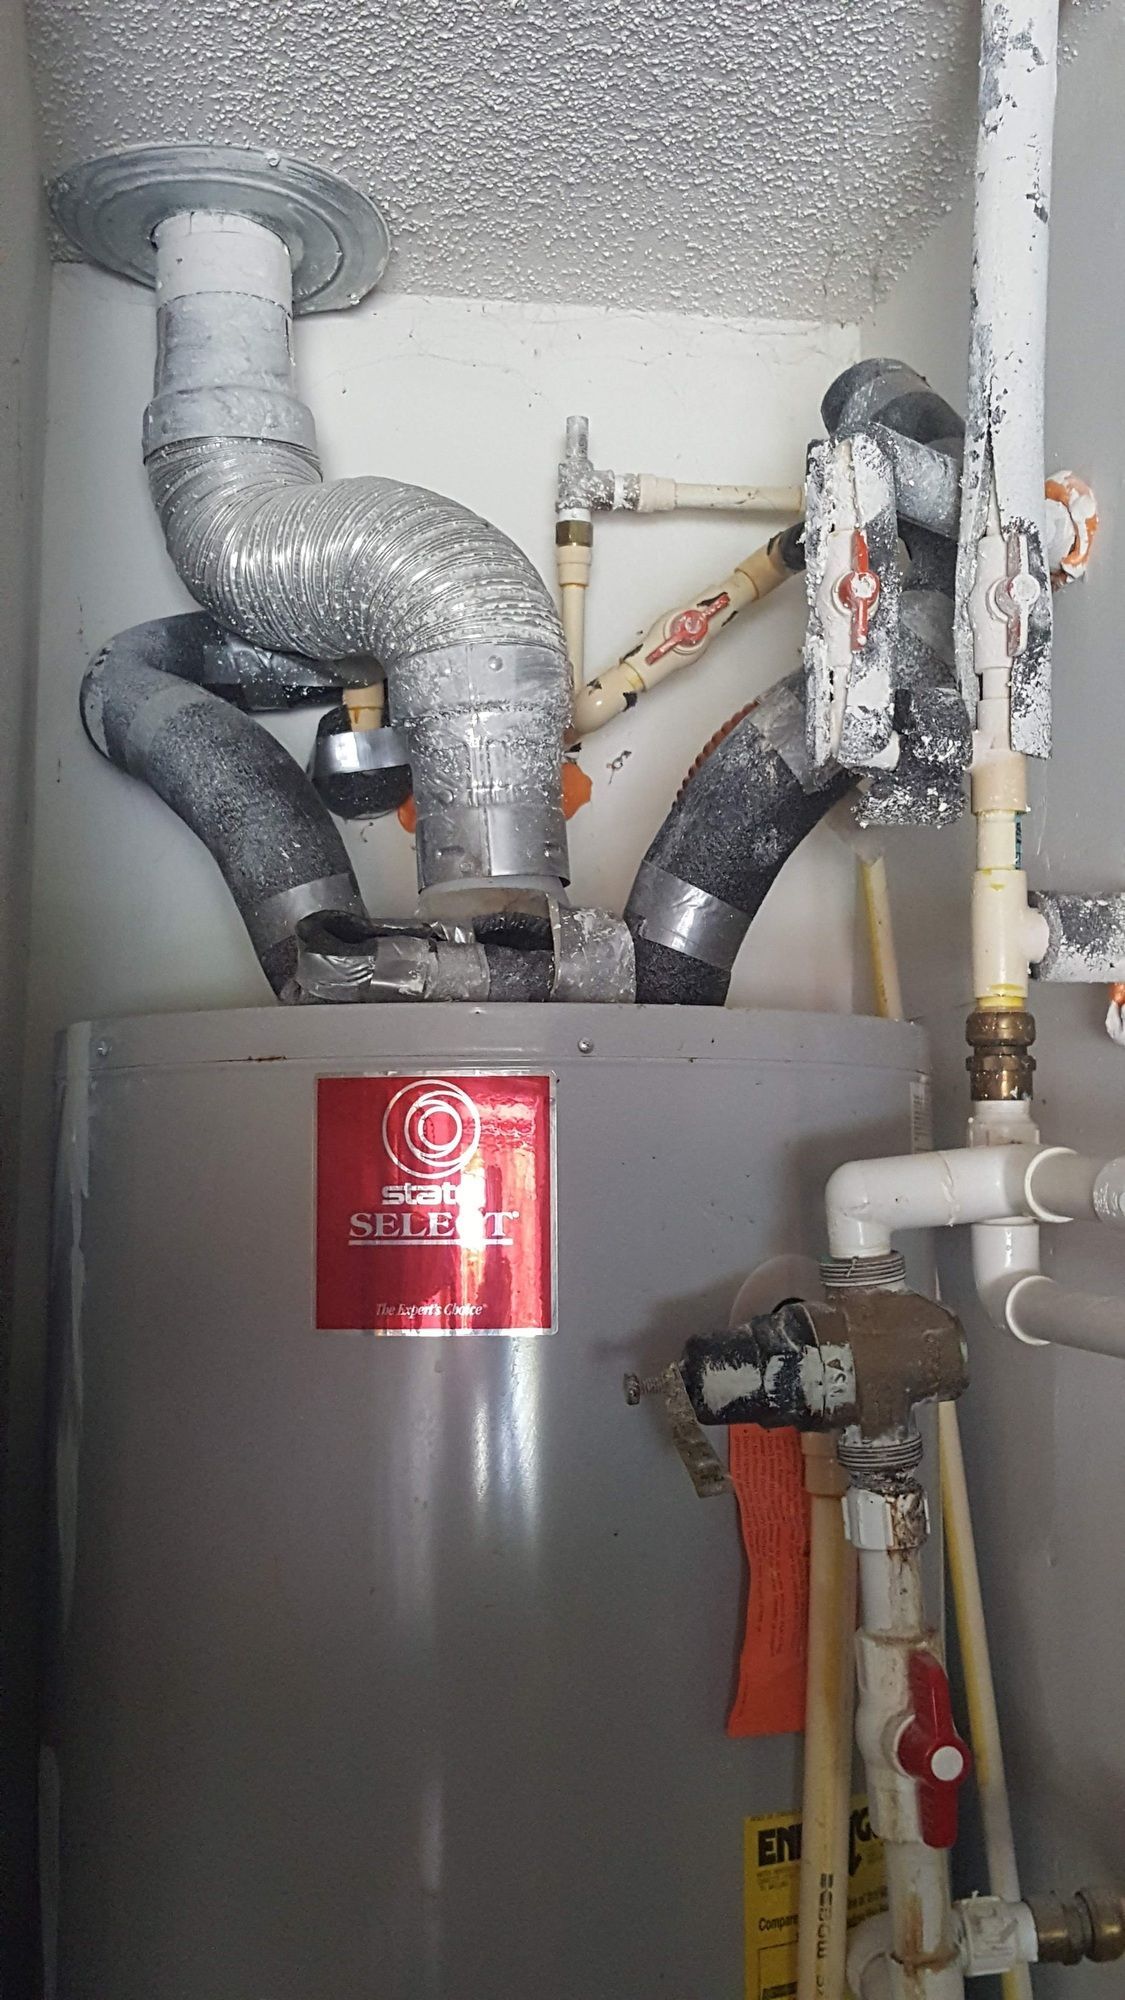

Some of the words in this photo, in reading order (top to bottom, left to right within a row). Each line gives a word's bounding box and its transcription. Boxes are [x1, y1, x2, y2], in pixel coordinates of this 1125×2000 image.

[382, 1182, 478, 1206] stat
[376, 1303, 397, 1316] The
[398, 1303, 444, 1320] Expert's
[445, 1303, 486, 1316] Choice
[758, 1914, 799, 1932] Compare
